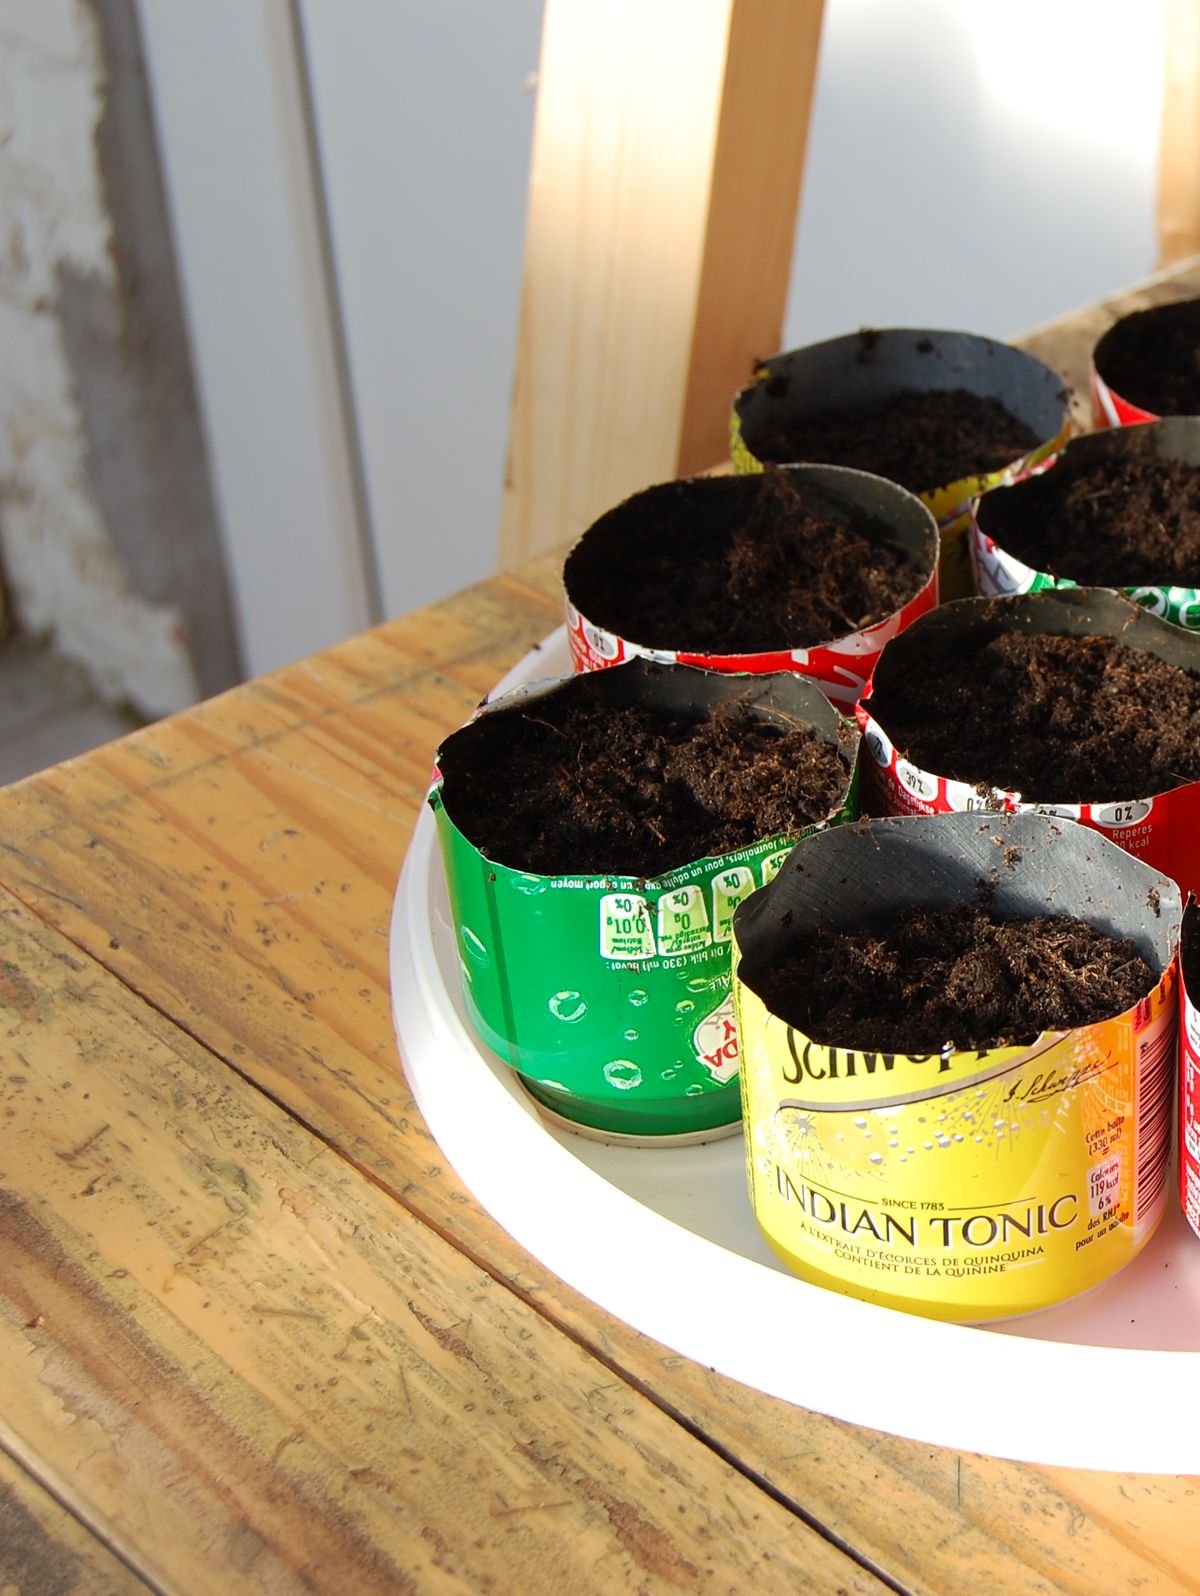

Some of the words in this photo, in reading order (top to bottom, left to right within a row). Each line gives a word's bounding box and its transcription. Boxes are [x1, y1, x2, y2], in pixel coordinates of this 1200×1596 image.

[551, 878, 583, 889] moyen
[691, 950, 708, 965] blik
[1090, 1179, 1105, 1199] 119
[776, 1167, 916, 1246] INDIAN
[929, 1195, 1079, 1247] TONIC
[881, 1197, 917, 1210] SINCE
[808, 1227, 861, 1256] L'EXTRAIT
[866, 1248, 937, 1267] D'ÉCORCES
[942, 1257, 960, 1267] DE
[963, 1245, 1045, 1267] QUINQUINA
[1075, 1234, 1095, 1252] pour
[1097, 1227, 1107, 1239] un
[833, 1248, 899, 1273] CONTIENT
[903, 1265, 922, 1276] DE
[926, 1266, 942, 1276] LA
[945, 1263, 1007, 1278] QUININE
